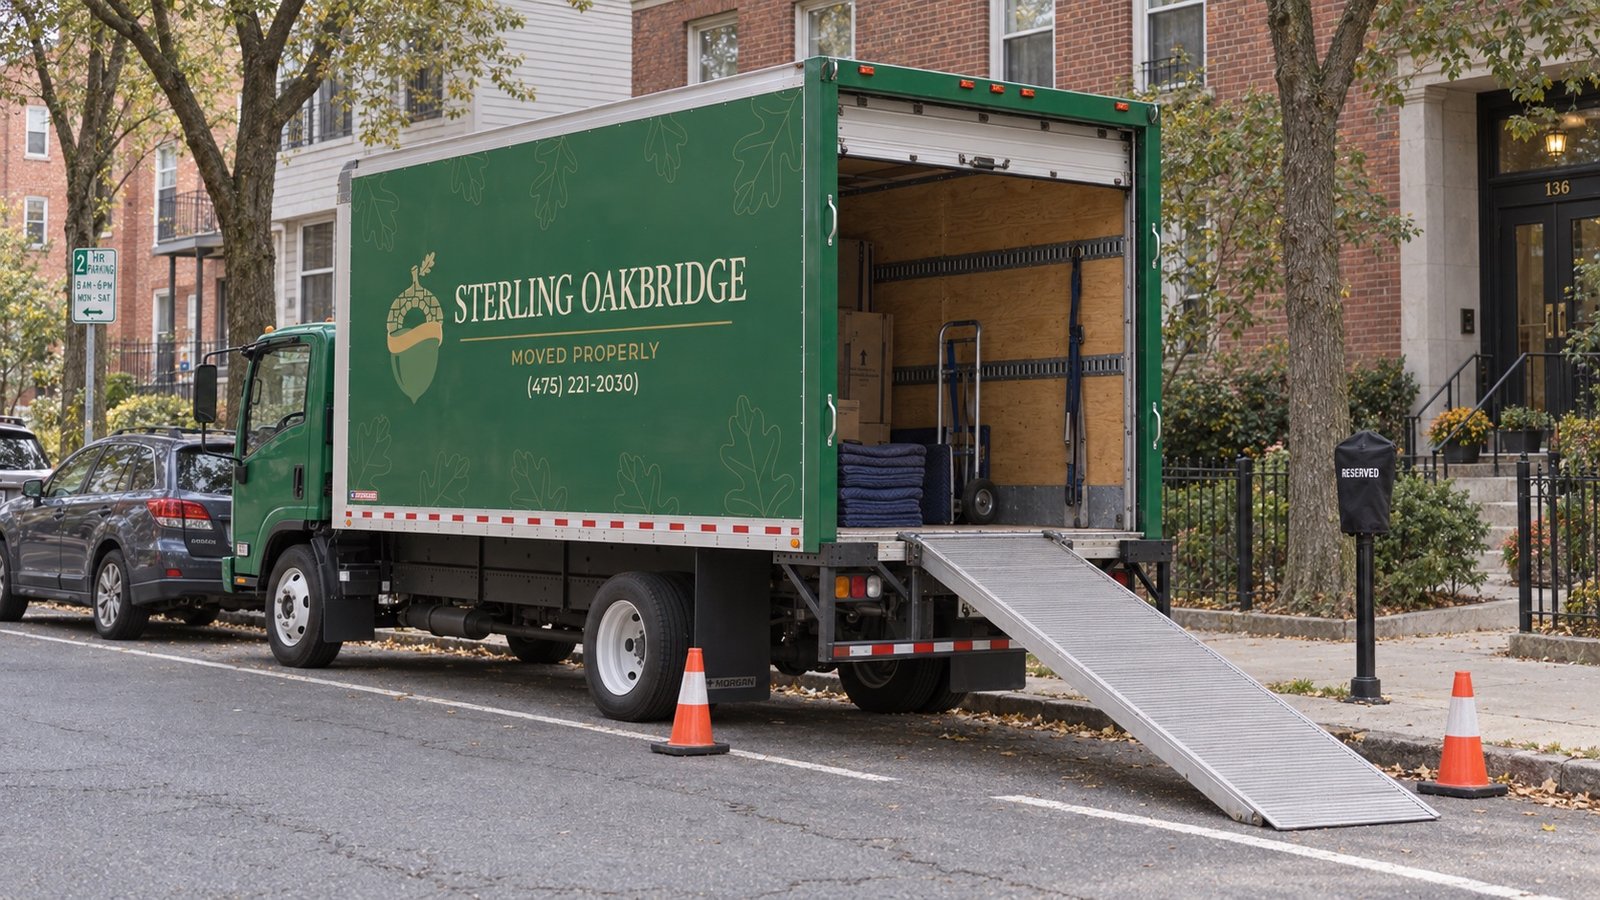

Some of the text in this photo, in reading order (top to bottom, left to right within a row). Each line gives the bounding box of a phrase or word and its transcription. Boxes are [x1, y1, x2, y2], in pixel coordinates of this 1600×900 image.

[1545, 180, 1570, 196] 136
[76, 253, 105, 272] 2 HR
[87, 264, 114, 274] PARKING
[455, 256, 747, 324] STERLING OAKBRIDGE
[511, 341, 660, 366] MOVED PROPERLY
[527, 372, 639, 399] (475) 221-2030)
[1341, 467, 1380, 478] RESERVED
[715, 678, 755, 687] MORGAN
